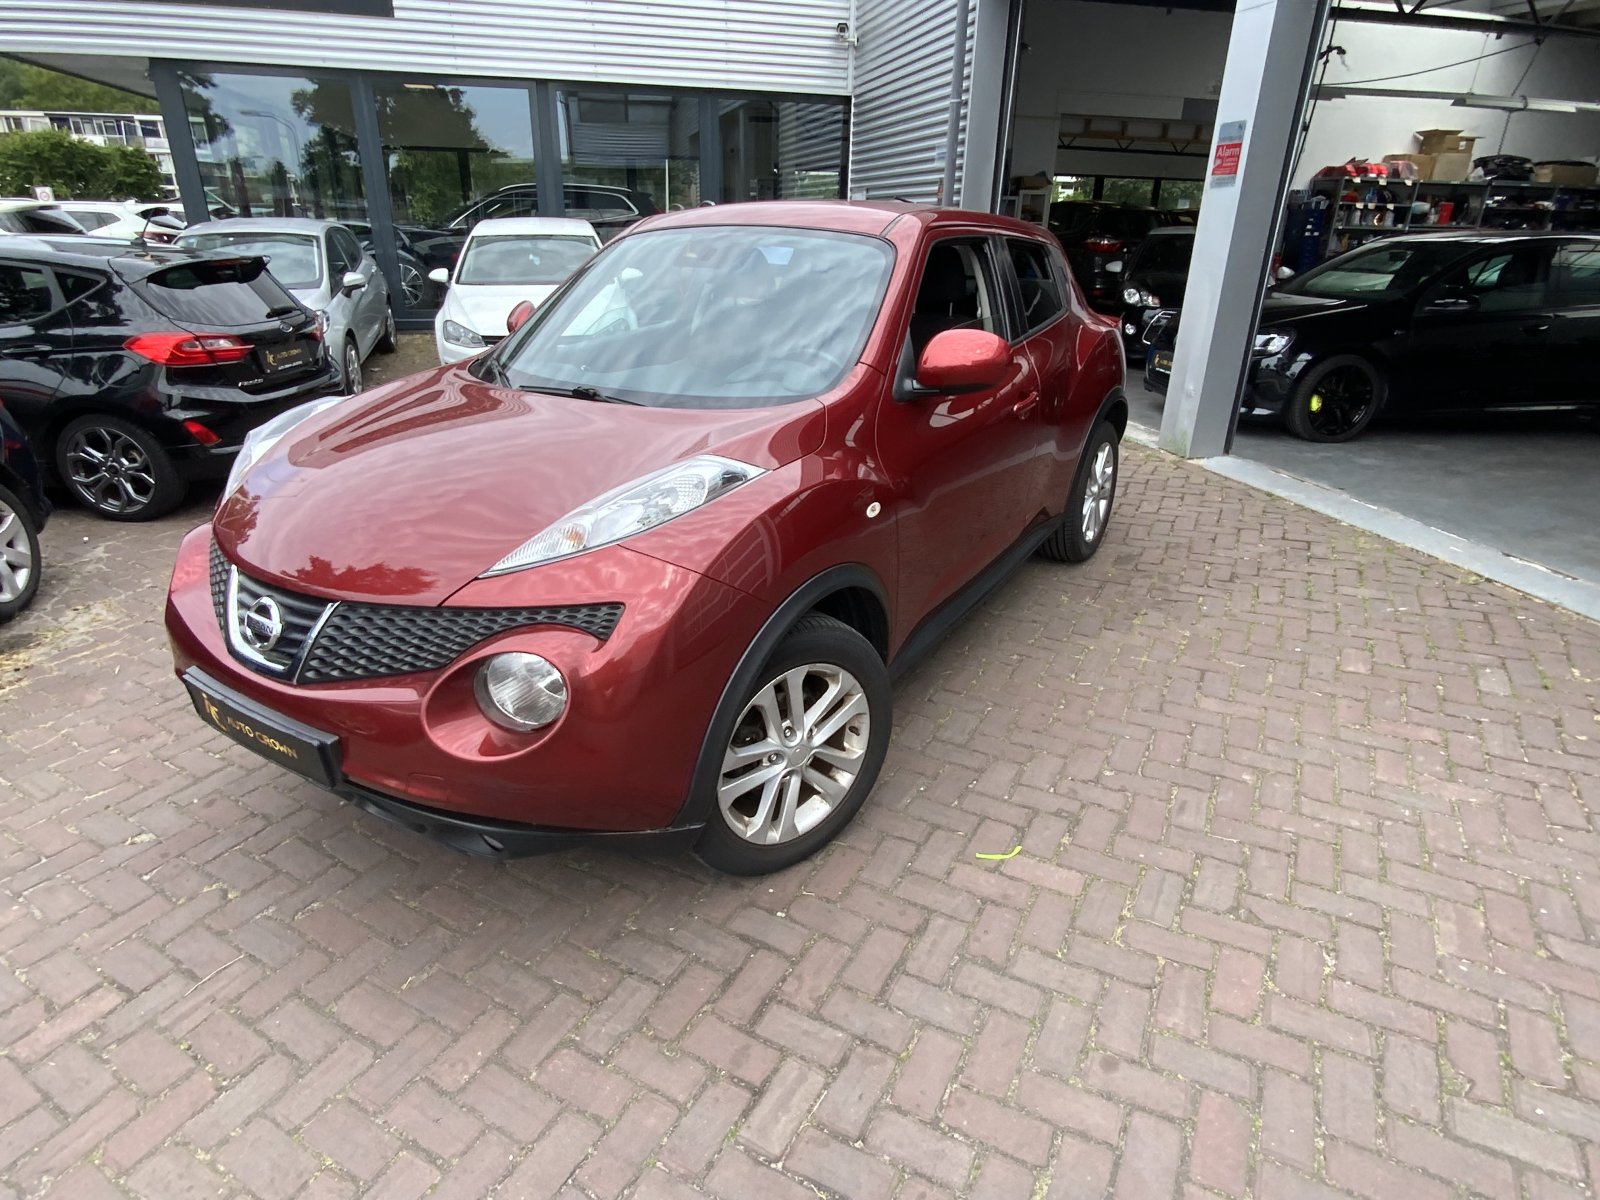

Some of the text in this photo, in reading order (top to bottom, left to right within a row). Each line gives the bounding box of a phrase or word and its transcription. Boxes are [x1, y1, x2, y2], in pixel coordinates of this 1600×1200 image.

[1216, 145, 1240, 157] Alarm
[227, 716, 298, 759] AUTO CROWN
